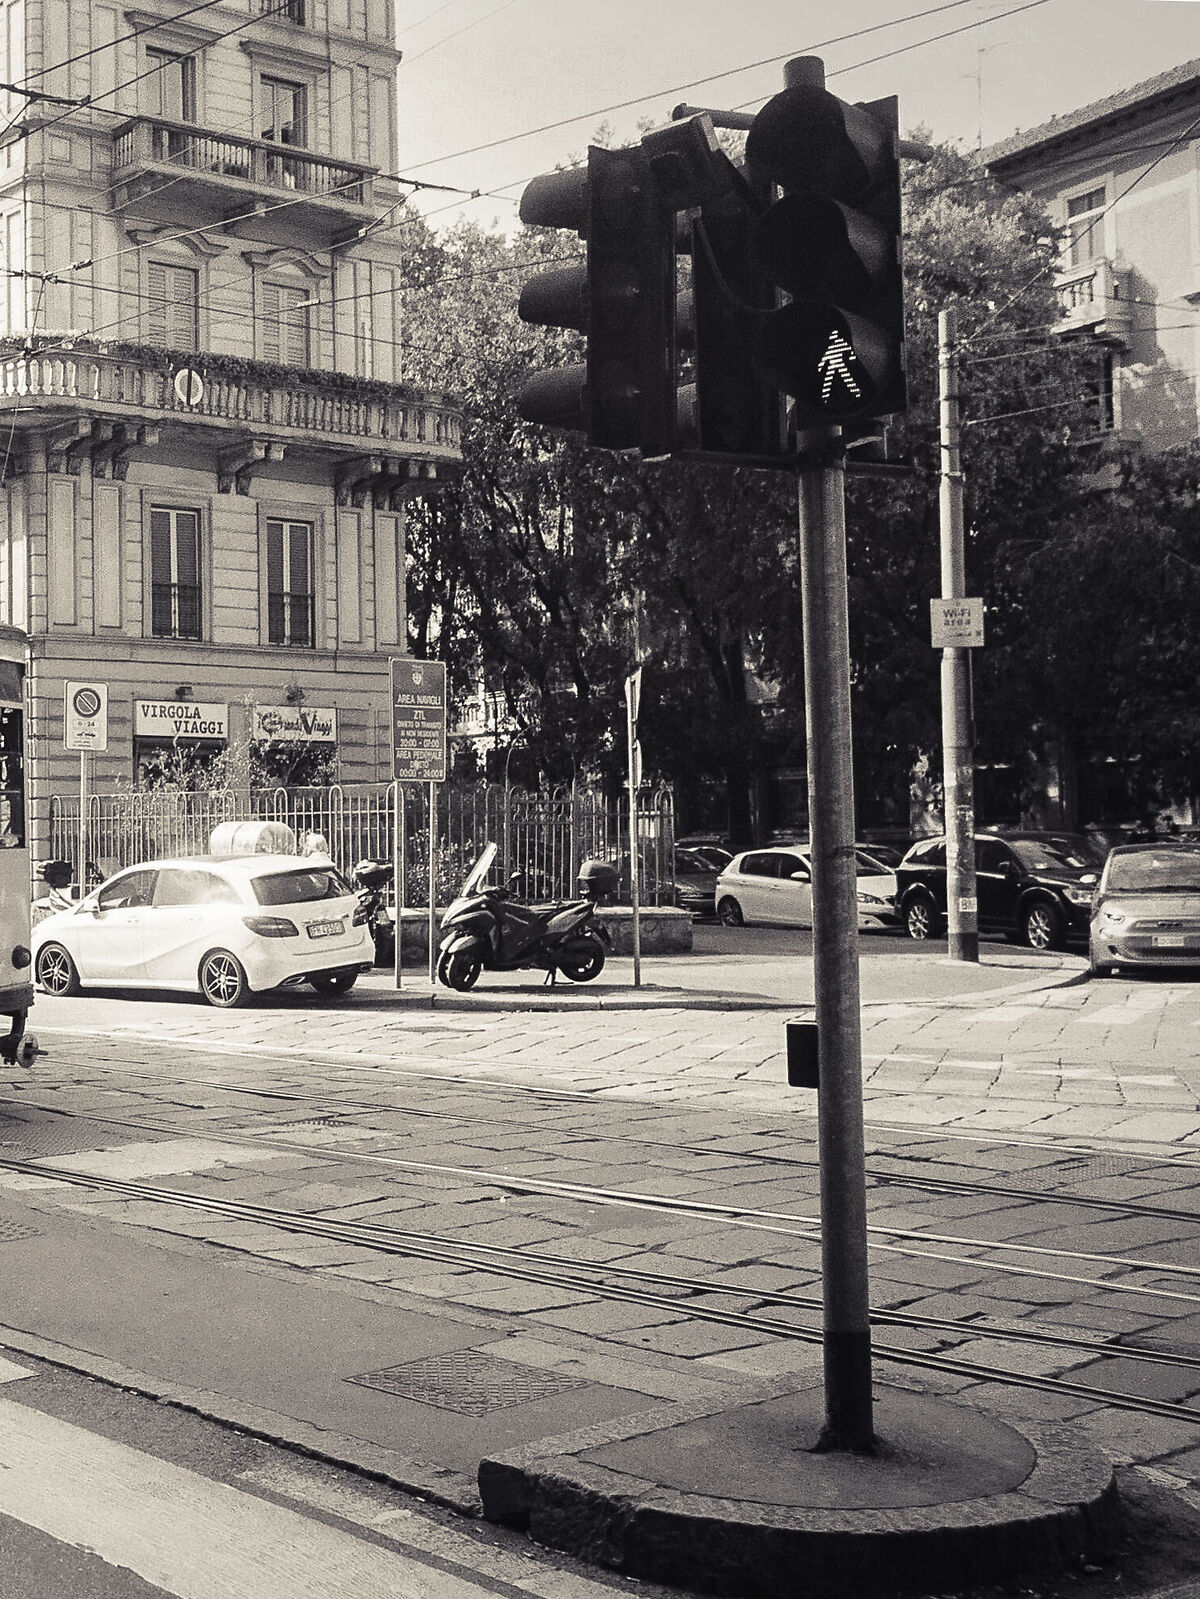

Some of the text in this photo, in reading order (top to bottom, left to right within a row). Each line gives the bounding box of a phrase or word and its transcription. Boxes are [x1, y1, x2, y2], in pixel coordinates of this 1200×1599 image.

[397, 693, 416, 704] AREA
[141, 704, 202, 719] VIRGOLA
[413, 710, 426, 720] ZTL
[173, 720, 224, 735] VIAGGI
[396, 750, 412, 759] AREA
